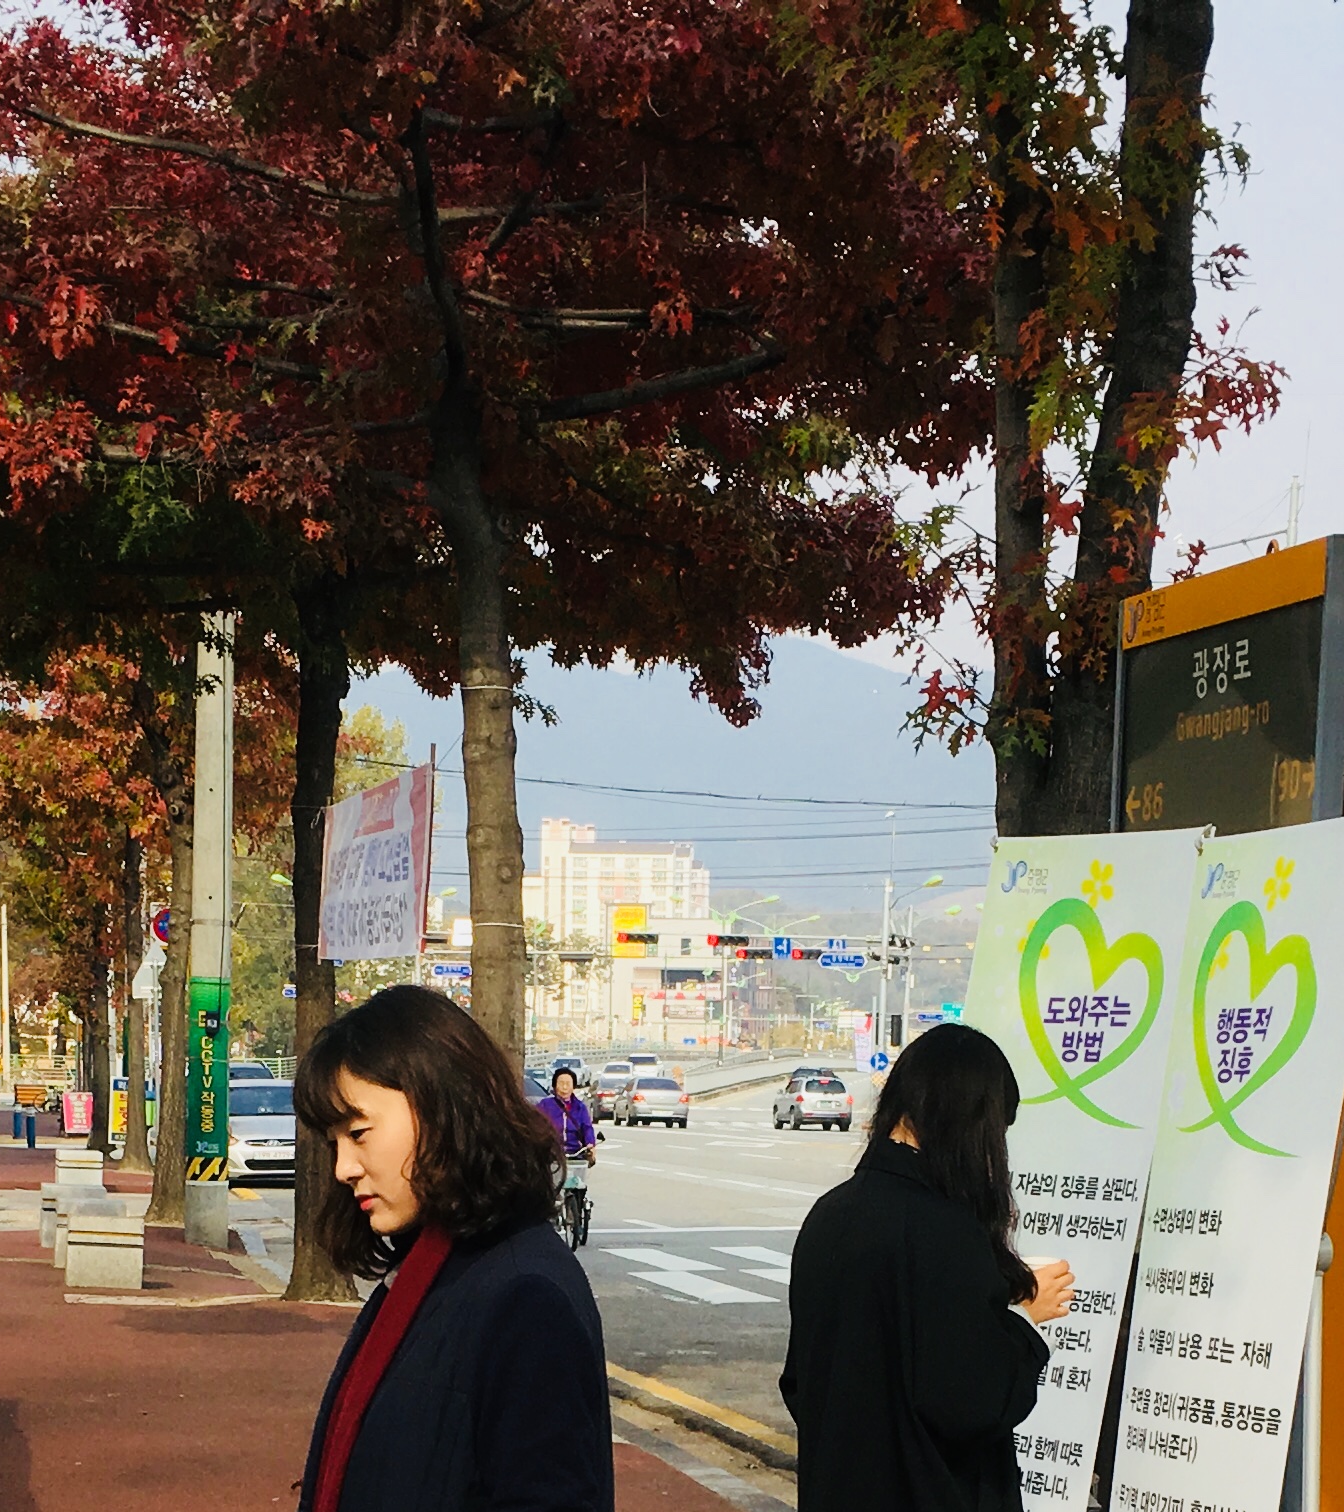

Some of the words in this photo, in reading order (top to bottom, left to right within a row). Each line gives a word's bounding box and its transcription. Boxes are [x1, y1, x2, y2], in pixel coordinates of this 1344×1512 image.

[1192, 639, 1251, 698] 광장로
[1176, 700, 1270, 741] Gwangjang-ro
[1142, 782, 1165, 821] 86
[1043, 995, 1131, 1027] 도와주는
[1217, 1006, 1274, 1042] 행동적
[1061, 1031, 1104, 1062] 방법
[1217, 1047, 1254, 1083] 징후
[1016, 1172, 1057, 1197] 자살의
[1061, 1175, 1099, 1201] 징후를
[1102, 1178, 1139, 1202] 살핀다.
[1023, 1211, 1064, 1236] 어떻게
[1066, 1214, 1127, 1241] 생각하는지
[1198, 1210, 1223, 1236] 변화
[1189, 1272, 1214, 1299] 변화
[1178, 1333, 1203, 1361] 남용
[1205, 1337, 1235, 1364] 또는
[1240, 1341, 1273, 1370] 자해
[1066, 1367, 1091, 1392] 혼자
[1035, 1437, 1059, 1463] 함께
[1148, 1431, 1198, 1463] 나눠준다)
